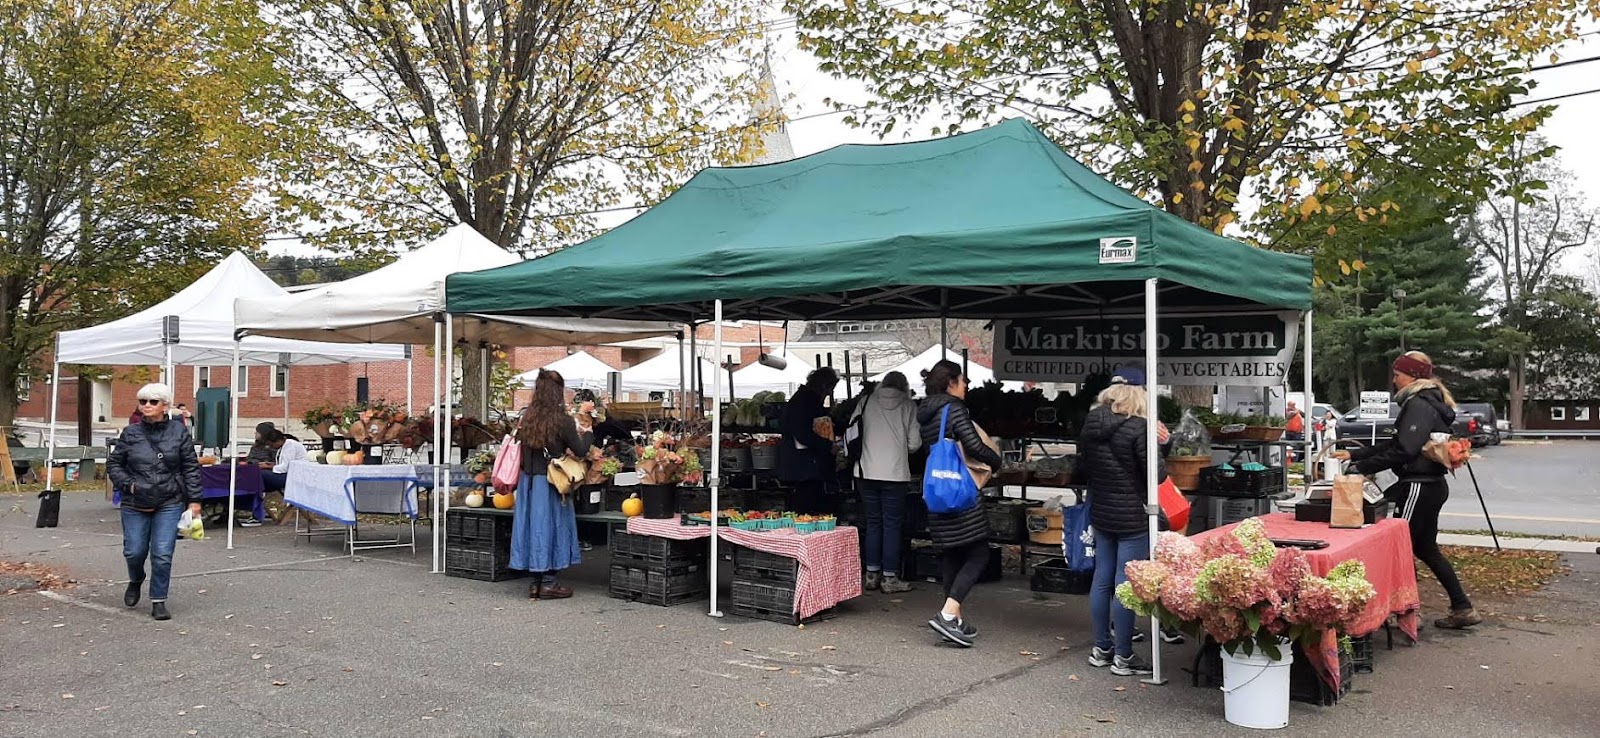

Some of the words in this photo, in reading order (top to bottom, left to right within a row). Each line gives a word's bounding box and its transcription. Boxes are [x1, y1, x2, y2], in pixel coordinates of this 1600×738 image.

[1101, 248, 1132, 258] Eurmax
[1012, 325, 1170, 351] Markristo
[1181, 324, 1277, 350] Farm
[1004, 360, 1085, 375] CERTIFIED
[1170, 362, 1285, 377] VEGETABLES
